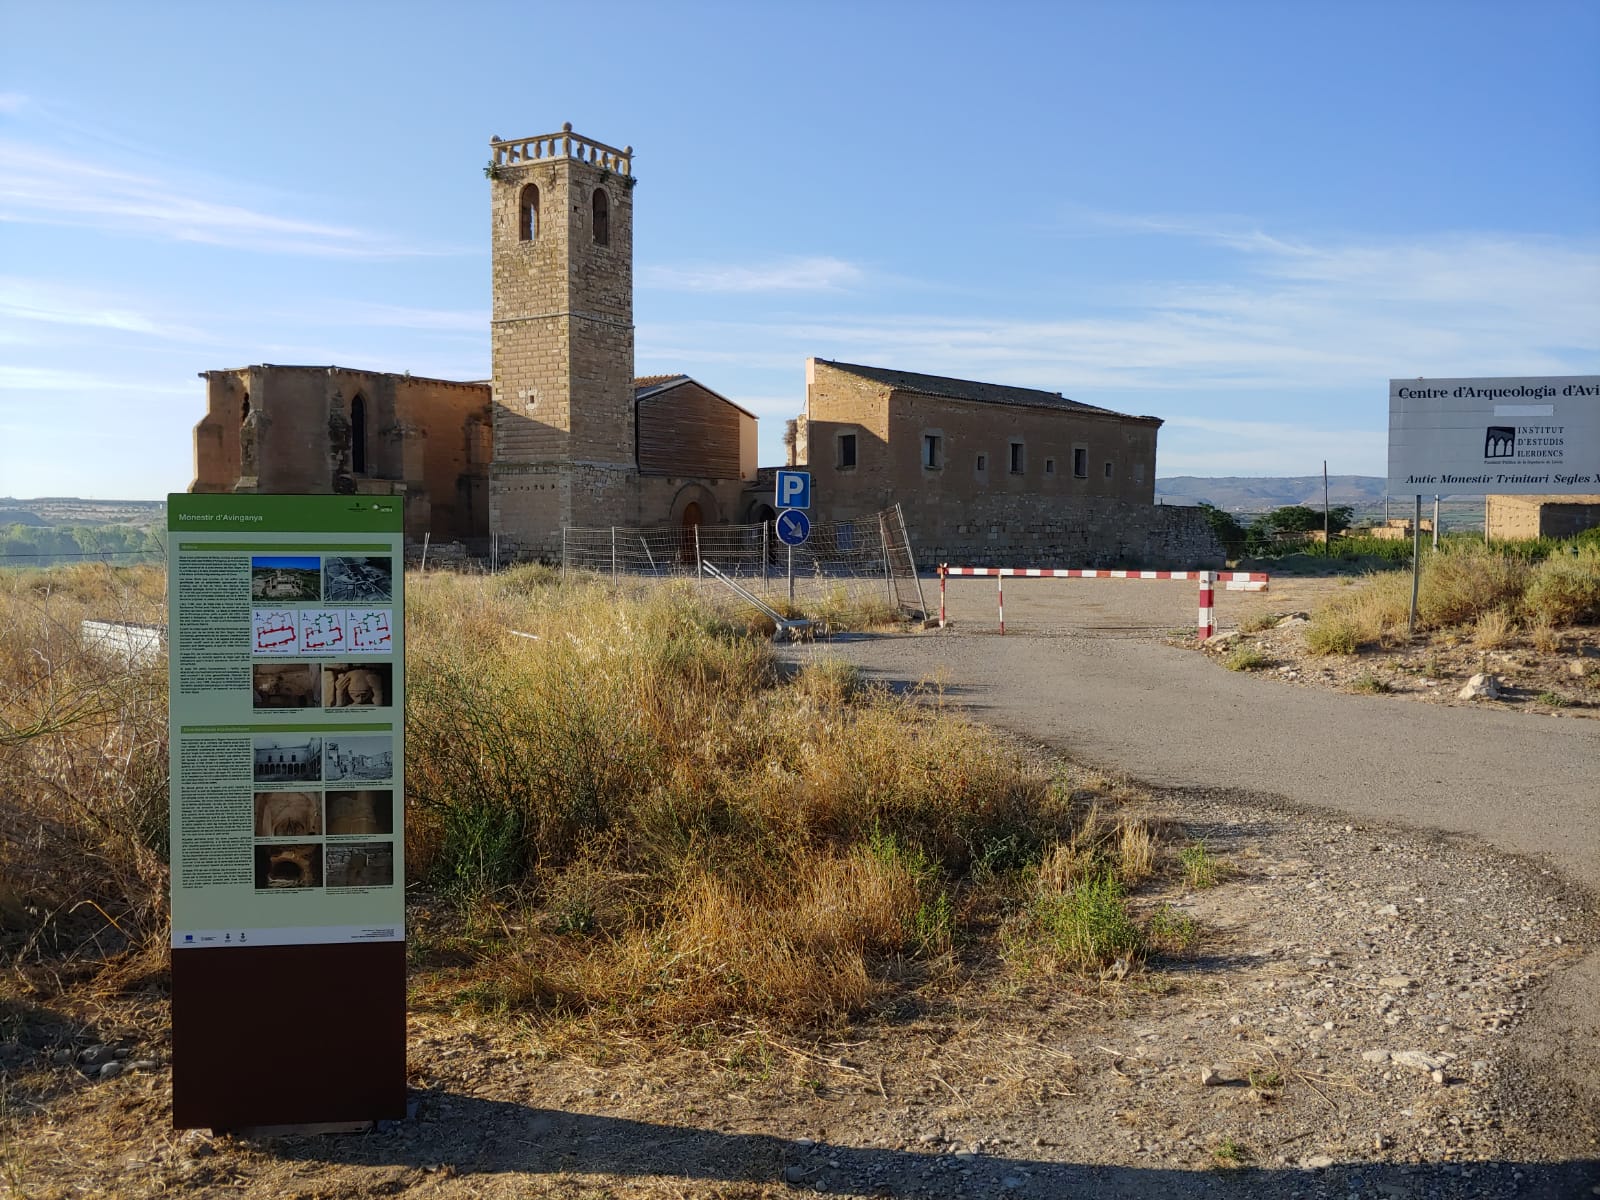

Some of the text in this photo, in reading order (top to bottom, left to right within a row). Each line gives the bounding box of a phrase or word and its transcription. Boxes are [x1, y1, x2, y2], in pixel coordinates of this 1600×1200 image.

[1398, 387, 1448, 399] Centre
[1453, 385, 1556, 401] d'Arqueologia
[1517, 426, 1565, 434] INSTITUT
[1517, 438, 1564, 446] D'ESTUDIS
[1517, 449, 1564, 458] ILERDENCS
[1405, 473, 1437, 484] Antic
[1440, 473, 1493, 484] Monestir
[1496, 473, 1550, 484] Trinitari
[1553, 472, 1591, 486] Segles
[783, 475, 804, 504] P
[178, 513, 263, 523] Monestir d'Avinganya
